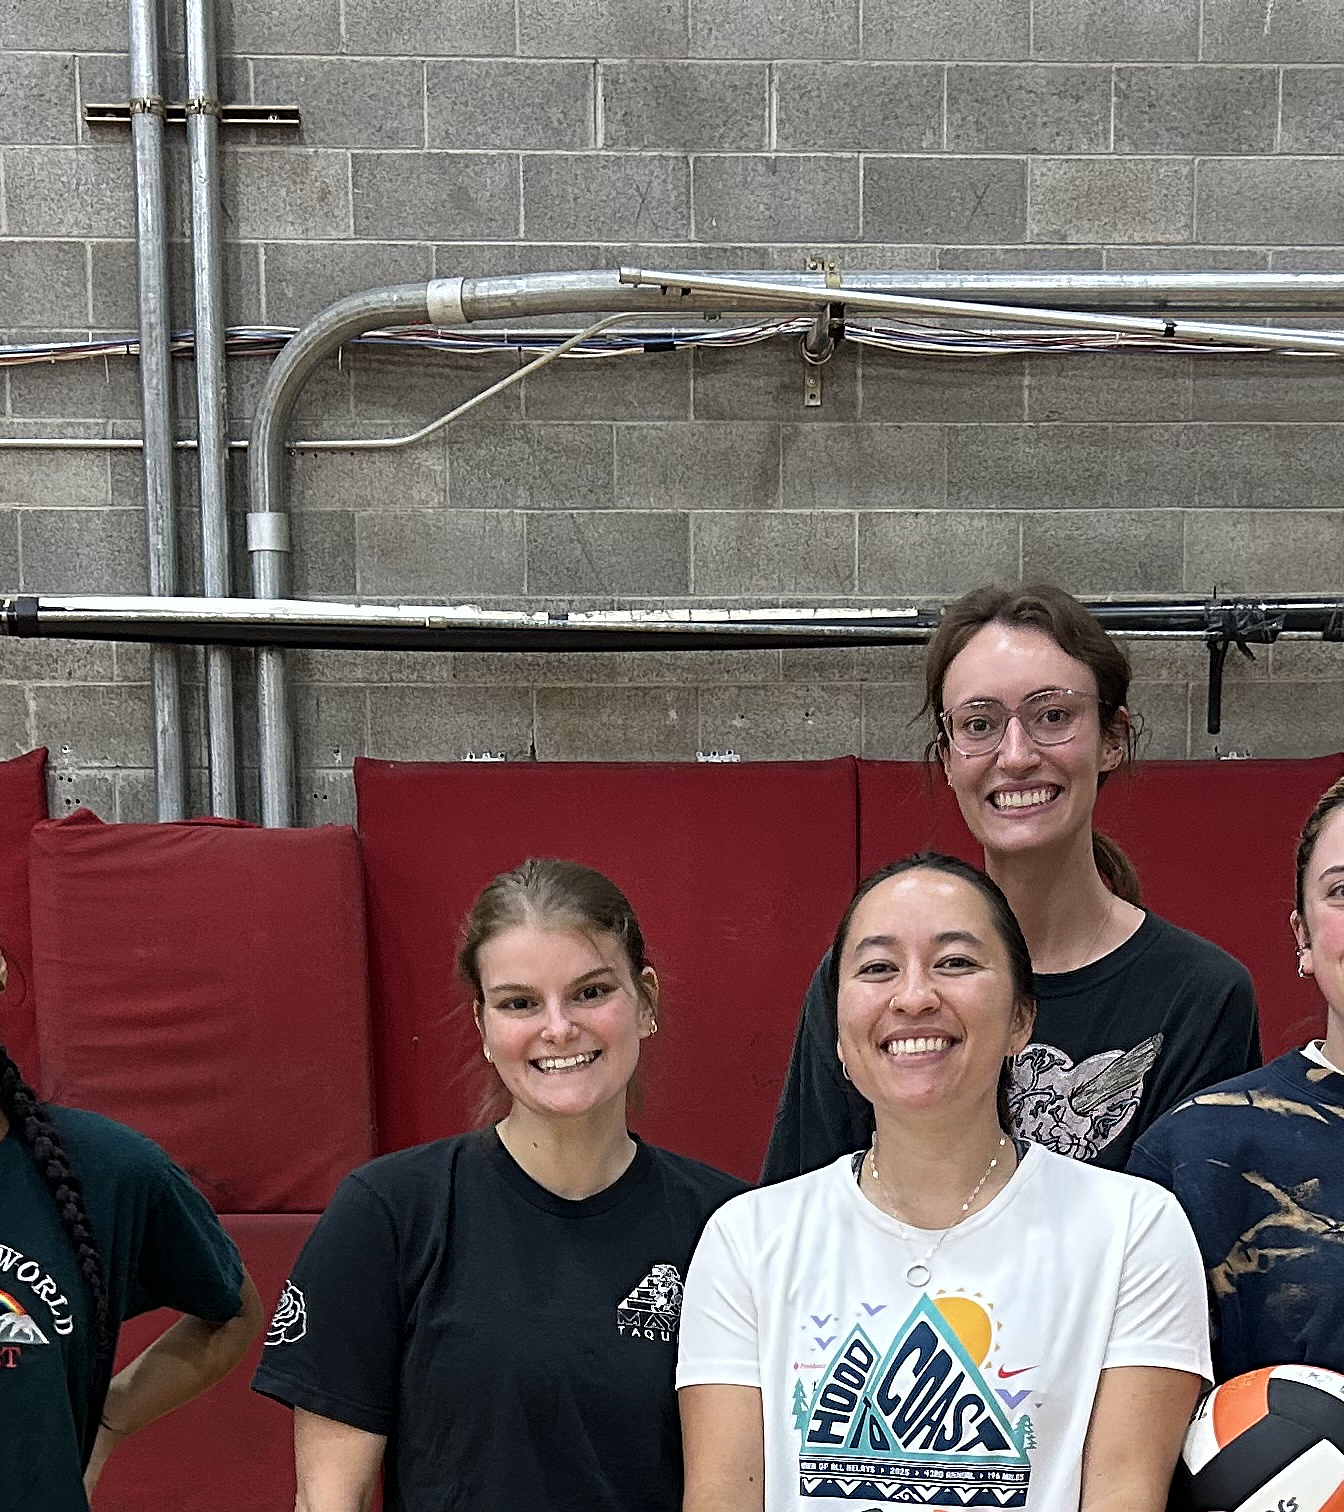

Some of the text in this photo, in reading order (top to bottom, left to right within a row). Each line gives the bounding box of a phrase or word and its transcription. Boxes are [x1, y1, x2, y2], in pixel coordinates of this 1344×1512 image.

[807, 1338, 874, 1445] HOOD
[848, 1396, 891, 1451] TO
[876, 1320, 1012, 1452] COAST
